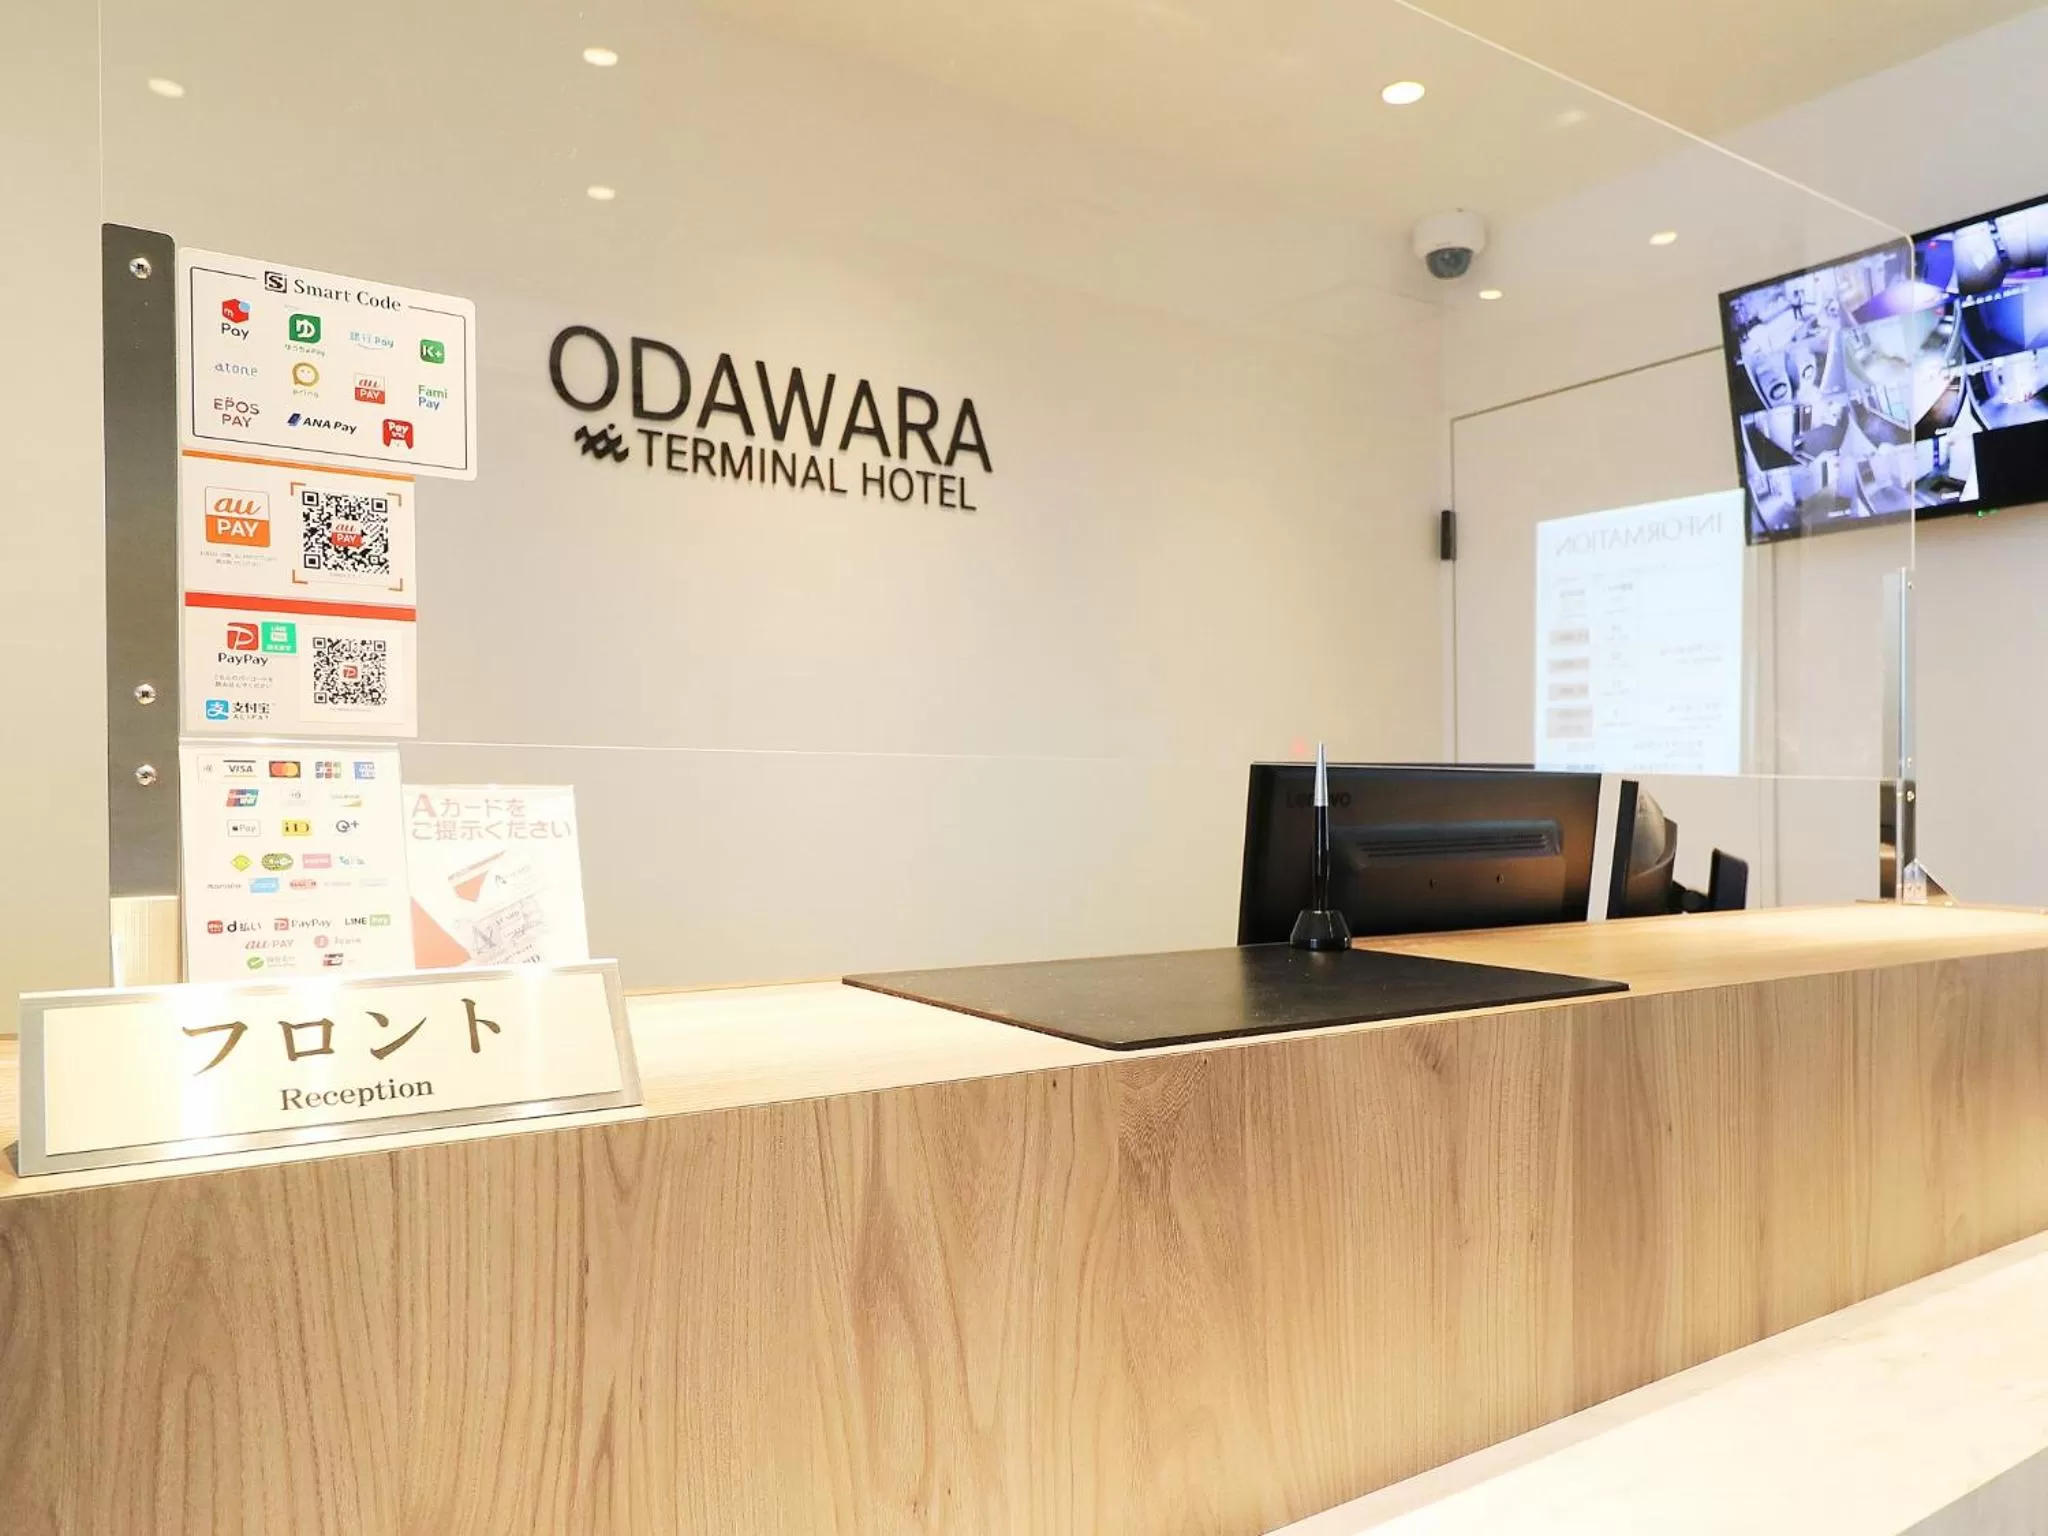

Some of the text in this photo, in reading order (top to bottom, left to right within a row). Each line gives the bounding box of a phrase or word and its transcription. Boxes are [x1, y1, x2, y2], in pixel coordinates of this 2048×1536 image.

[294, 279, 351, 302] Smart
[357, 291, 401, 312] Code
[220, 323, 249, 341] Pay
[215, 362, 258, 377] atone
[360, 388, 381, 401] PAY
[418, 385, 448, 399] Fami
[549, 325, 993, 473] ODAWARA
[213, 397, 260, 415] EPOS
[418, 396, 440, 411] Pay
[221, 414, 252, 428] PAY
[303, 416, 357, 435] ANA Pay
[637, 428, 977, 511] TERMINAL HOTEL
[214, 498, 261, 515] au
[217, 520, 259, 538] PAY
[335, 524, 356, 532] au
[336, 533, 358, 544] PAY
[218, 652, 268, 666] PayPay
[228, 765, 253, 773] VISA
[1286, 788, 1351, 808] Lenvo
[412, 819, 571, 841] ご提示ください
[291, 918, 332, 928] PayPay
[345, 917, 367, 926] LINE
[273, 940, 294, 949] PAY
[181, 997, 502, 1077] フロント
[280, 1076, 434, 1112] Reception
